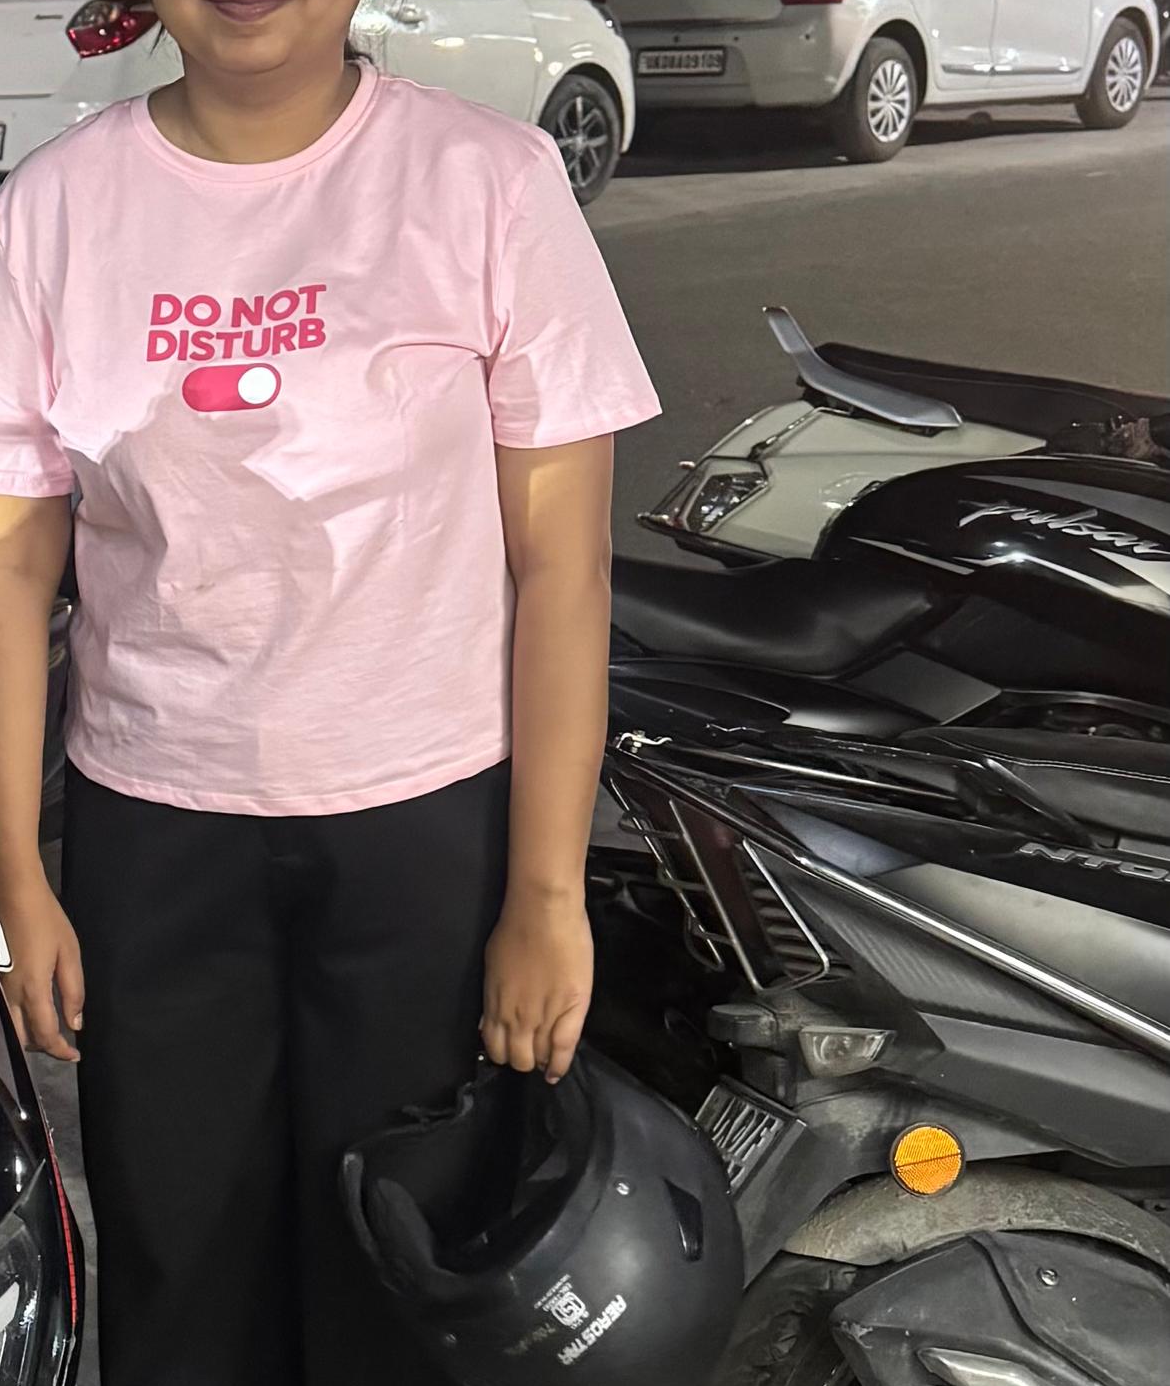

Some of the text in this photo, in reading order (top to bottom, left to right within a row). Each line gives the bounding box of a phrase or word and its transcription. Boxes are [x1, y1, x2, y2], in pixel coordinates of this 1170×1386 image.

[150, 284, 327, 328] DO NOT
[146, 318, 327, 362] DISTURB
[1015, 842, 1170, 882] NTO
[557, 1294, 627, 1365] AEROSTAR
